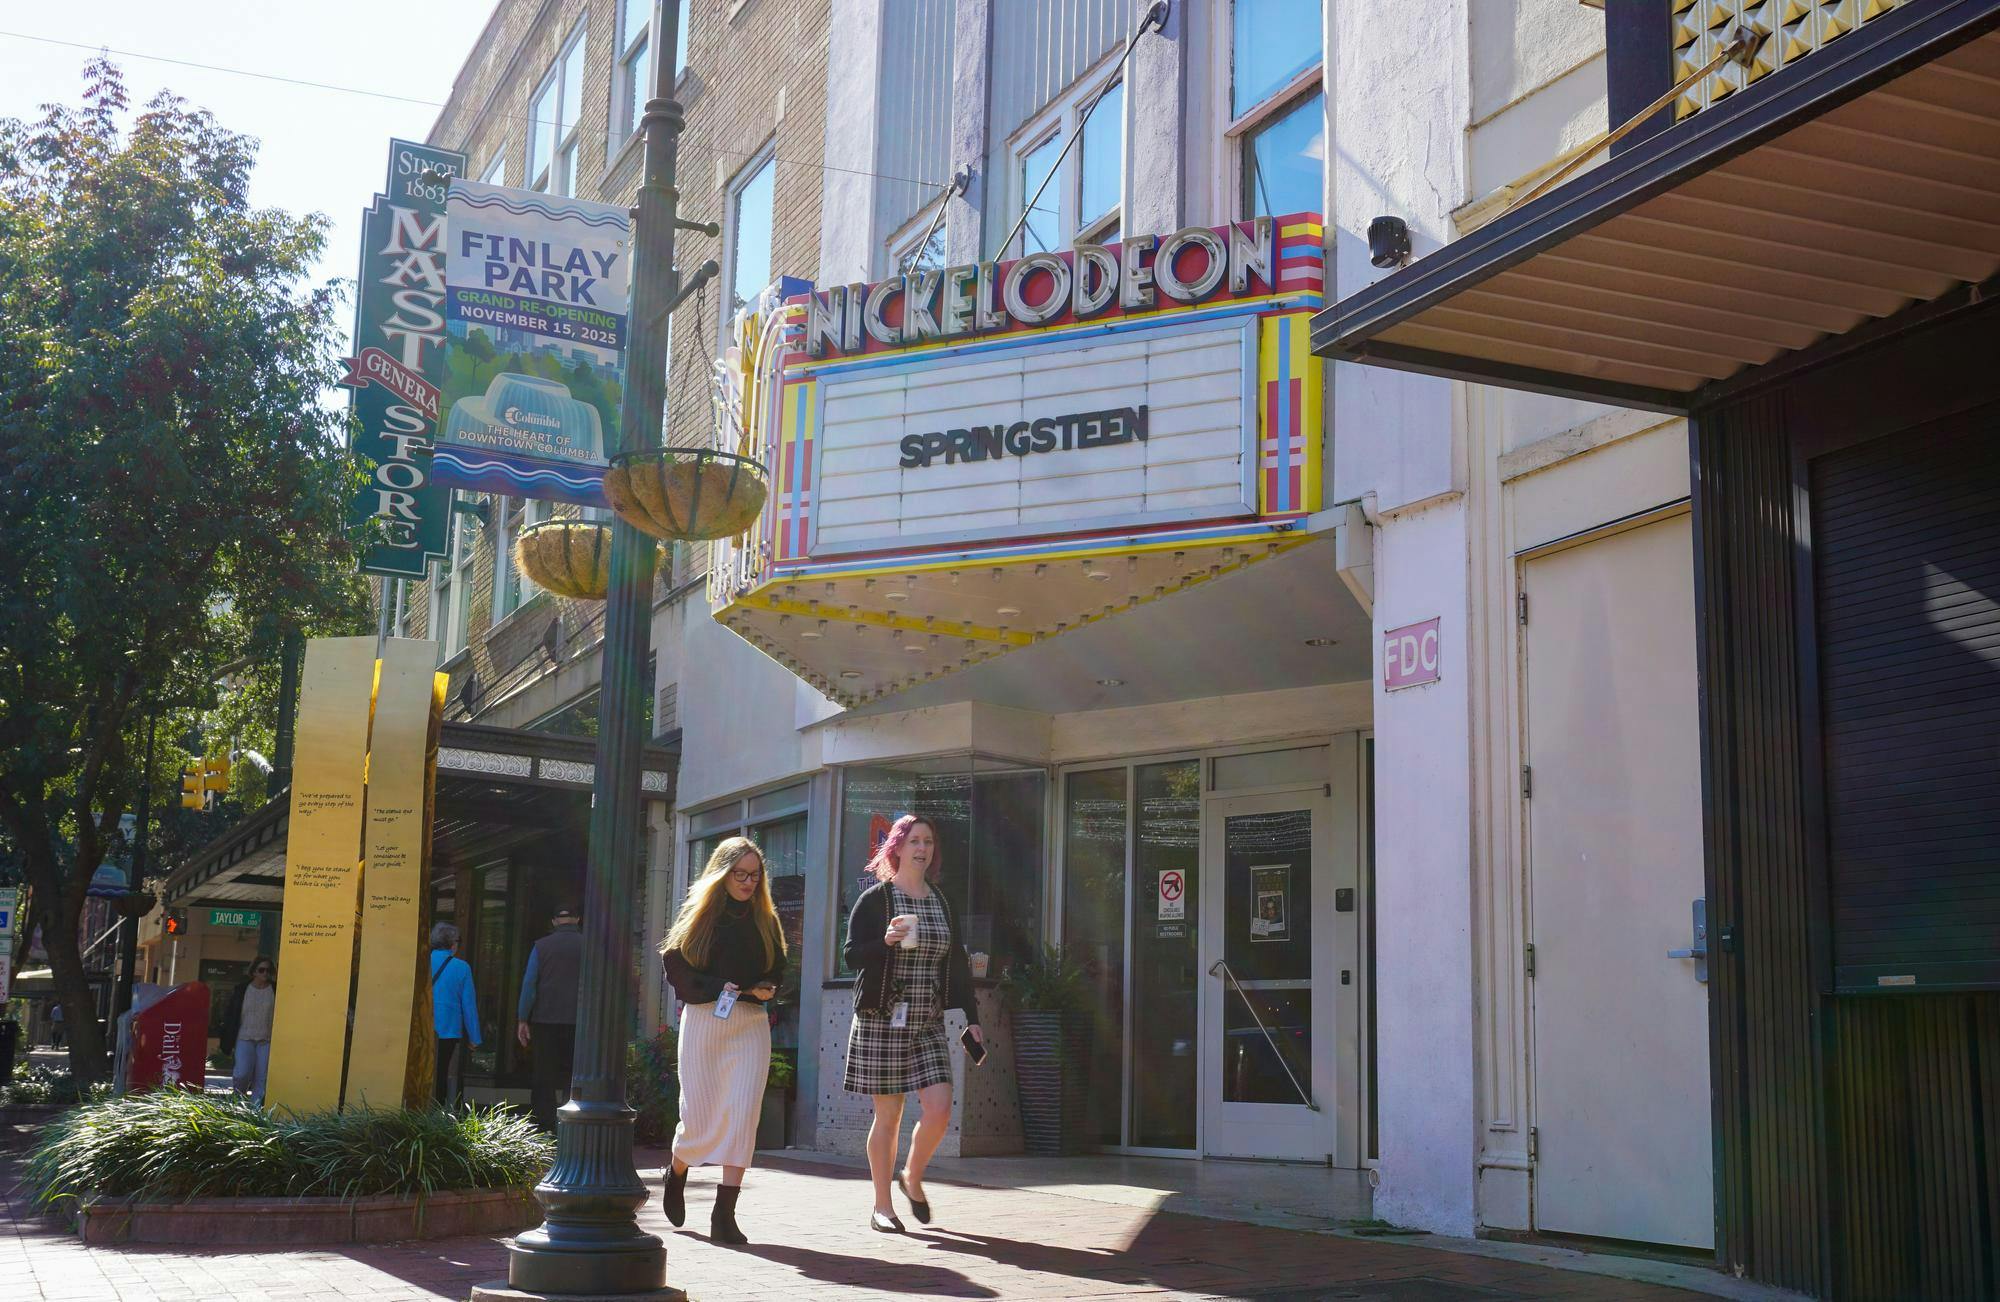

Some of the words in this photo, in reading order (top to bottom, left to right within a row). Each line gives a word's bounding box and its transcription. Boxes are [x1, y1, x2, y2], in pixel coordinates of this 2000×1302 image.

[461, 230, 619, 279] FINLAY
[484, 261, 597, 306] PARK
[807, 215, 1277, 358] NICKELODEON
[456, 289, 516, 310] GRAND
[519, 299, 618, 330] RE-OPENING
[460, 305, 548, 332] NOVEMBER
[552, 321, 577, 339] 15,
[580, 327, 617, 345] 2025
[365, 352, 440, 417] GENERA
[487, 424, 509, 436] THE
[513, 426, 553, 442] HEART
[555, 434, 572, 446] OF
[514, 409, 561, 430] Columbia
[899, 404, 1150, 469] SPRINGSTEEN
[458, 430, 533, 451] DOWNTOWN
[537, 442, 600, 461] COLUMBIA
[371, 404, 429, 550] STORE
[1384, 628, 1438, 681] FDC
[215, 911, 244, 925] TAYLOR
